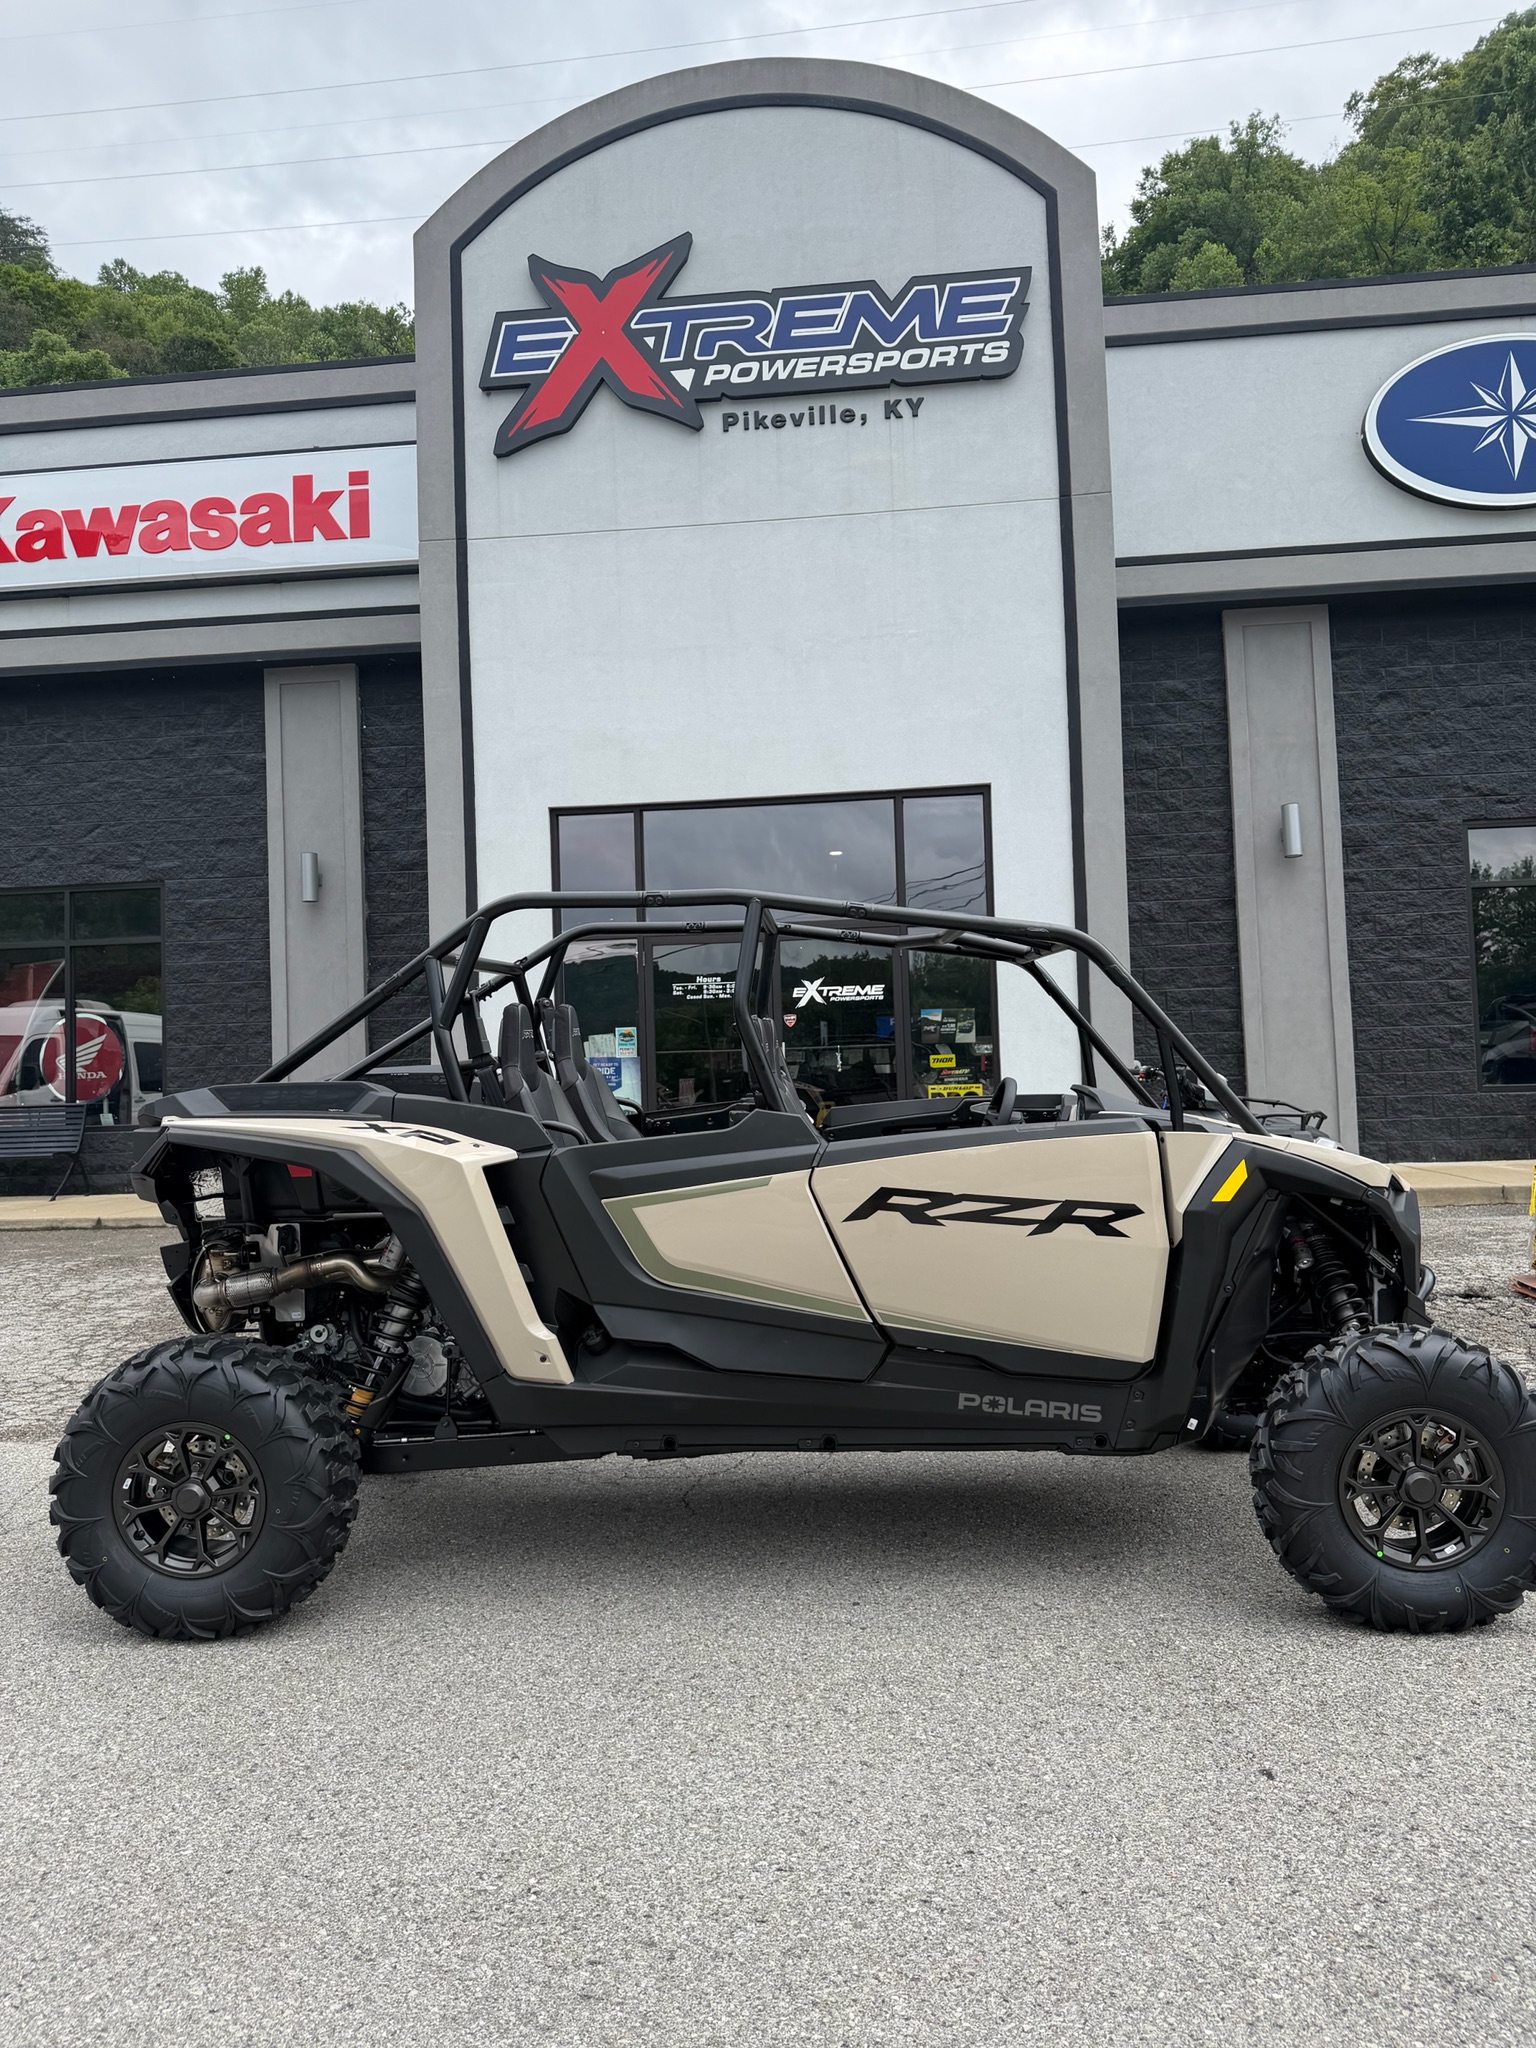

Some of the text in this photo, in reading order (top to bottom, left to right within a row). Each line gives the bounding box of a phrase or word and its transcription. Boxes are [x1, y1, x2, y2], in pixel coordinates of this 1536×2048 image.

[490, 250, 1021, 439] EXTREME
[703, 340, 1010, 387] POWERSPORTS
[721, 397, 925, 433] Pikeville, KY
[0, 470, 370, 563] awasaki
[696, 975, 721, 983] Hours
[58, 1071, 107, 1080] HNDA
[841, 1186, 1146, 1238] RZR
[957, 1392, 1103, 1424] POLARIS
